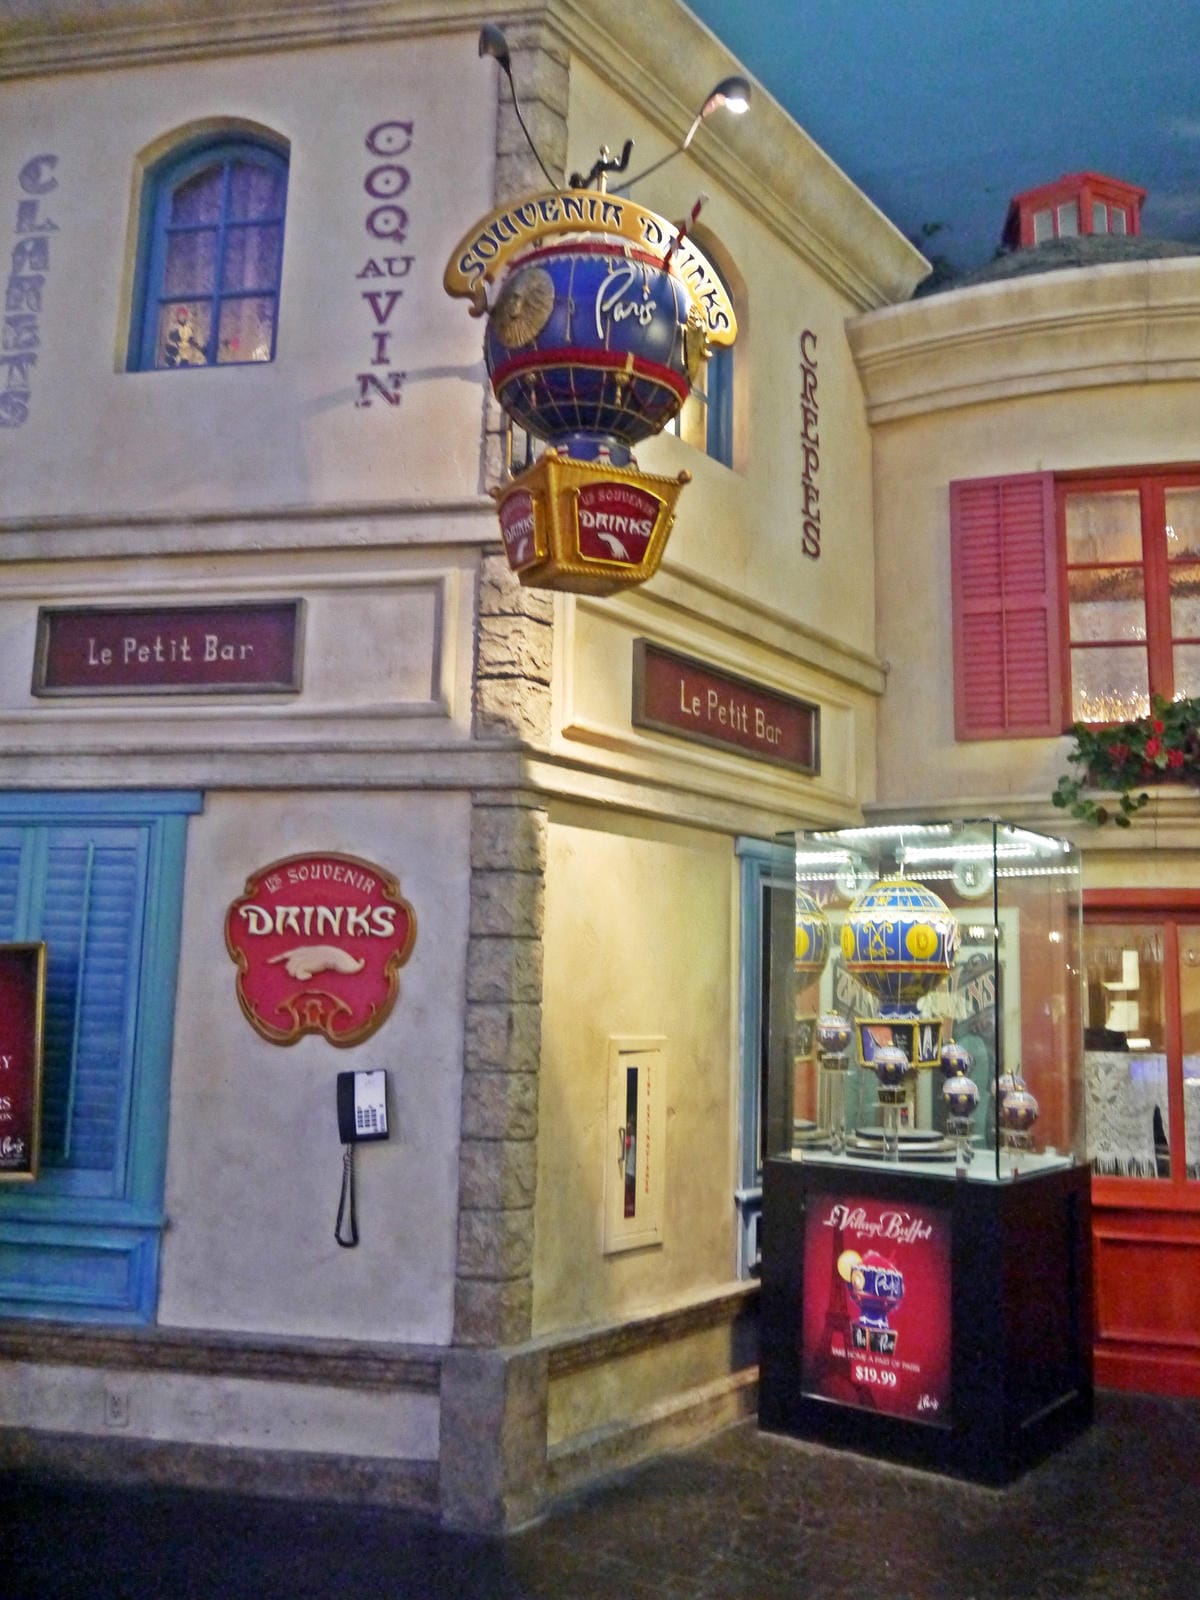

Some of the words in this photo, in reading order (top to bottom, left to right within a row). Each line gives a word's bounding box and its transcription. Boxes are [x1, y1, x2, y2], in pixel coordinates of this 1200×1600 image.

[364, 121, 414, 243] COQ
[458, 196, 624, 291] SOUVENIR
[355, 256, 415, 279] AU
[595, 267, 658, 339] Paris
[354, 290, 407, 408] VIN
[800, 328, 821, 560] CREPES
[578, 508, 654, 538] DRINKS
[87, 637, 113, 666] Le
[123, 635, 193, 665] Petit
[203, 634, 254, 662] Bar
[679, 679, 702, 717] Le
[707, 689, 749, 734] Petit
[754, 707, 783, 745] Bar
[286, 864, 376, 895] SOUVENIR
[238, 903, 397, 938] DRINKS
[832, 1204, 884, 1239] Village
[880, 1209, 933, 1244] Buffet
[855, 1364, 897, 1388] $19.99
